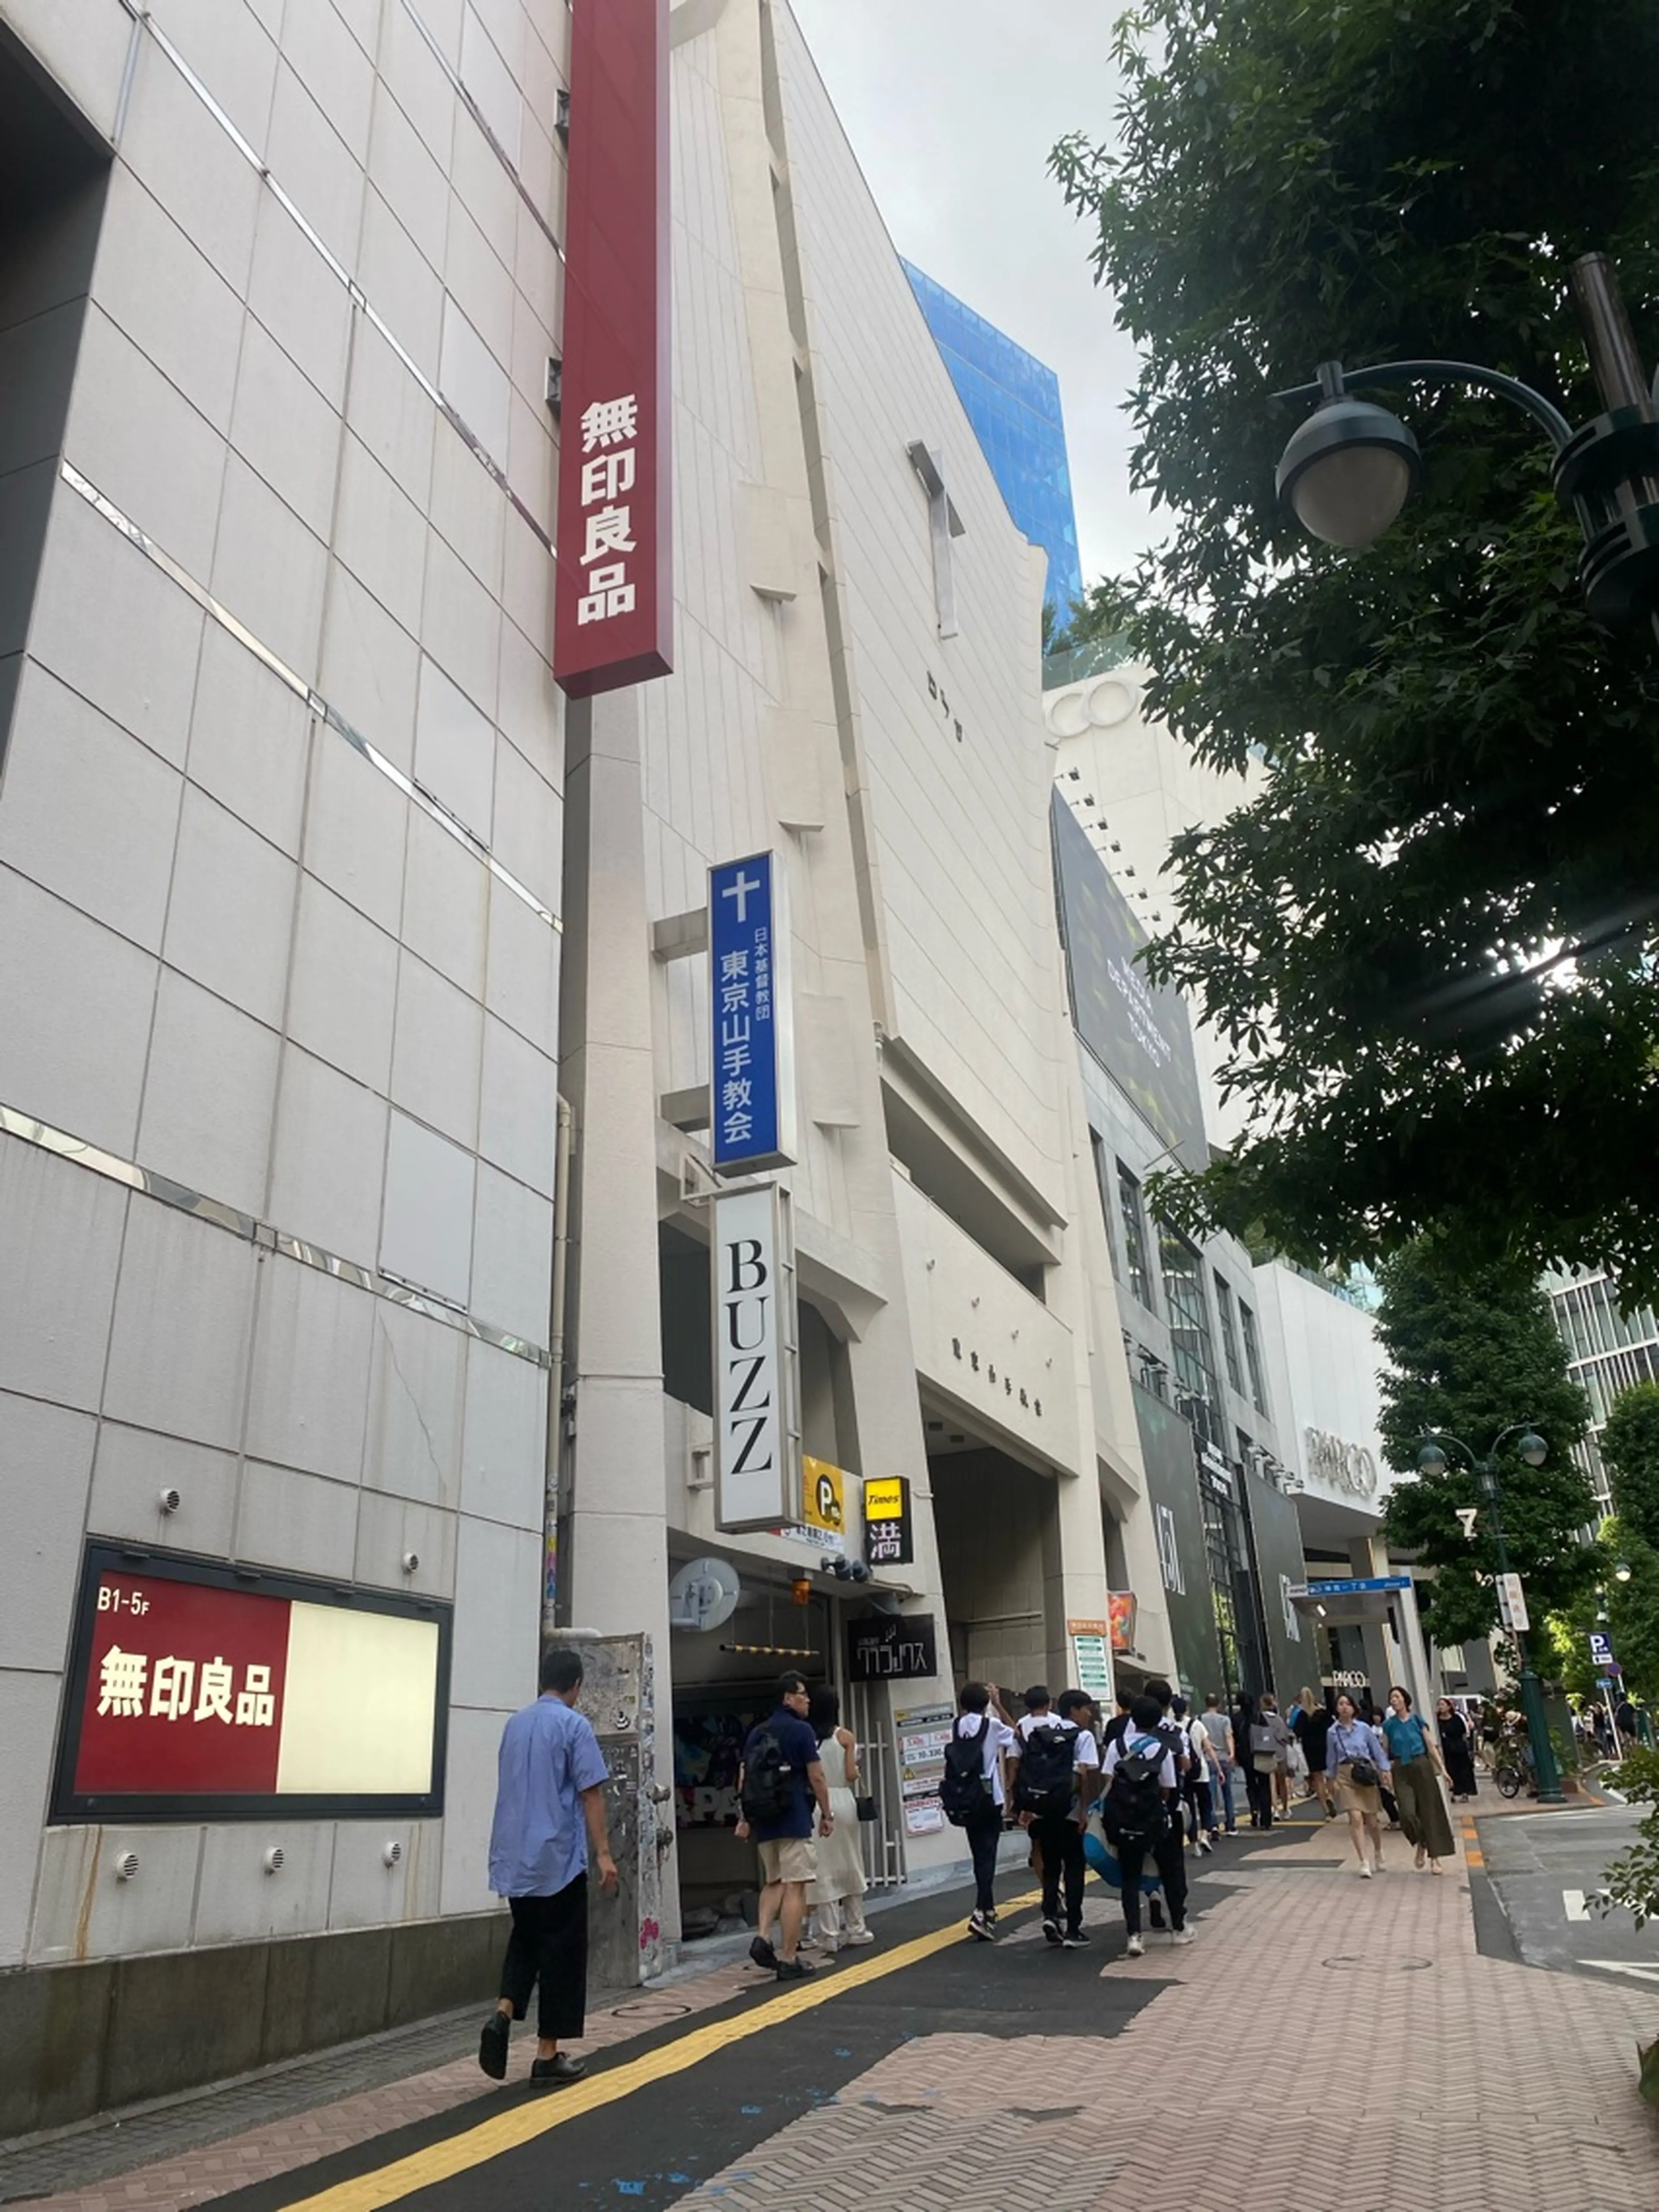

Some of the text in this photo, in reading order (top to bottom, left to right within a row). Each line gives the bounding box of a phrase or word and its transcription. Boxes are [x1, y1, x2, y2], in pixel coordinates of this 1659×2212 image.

[578, 394, 638, 626] 無印良品
[754, 927, 770, 1021] 日本基督教団
[720, 949, 753, 1144] 東京山手教会
[725, 1238, 772, 1475] BUZZ
[868, 1495, 899, 1506] Times
[870, 1522, 902, 1560] 満
[97, 1586, 150, 1616] B1-5F
[1590, 1635, 1605, 1653] P
[97, 1645, 275, 1727] 無印良品
[1332, 1670, 1366, 1688] PARCO
